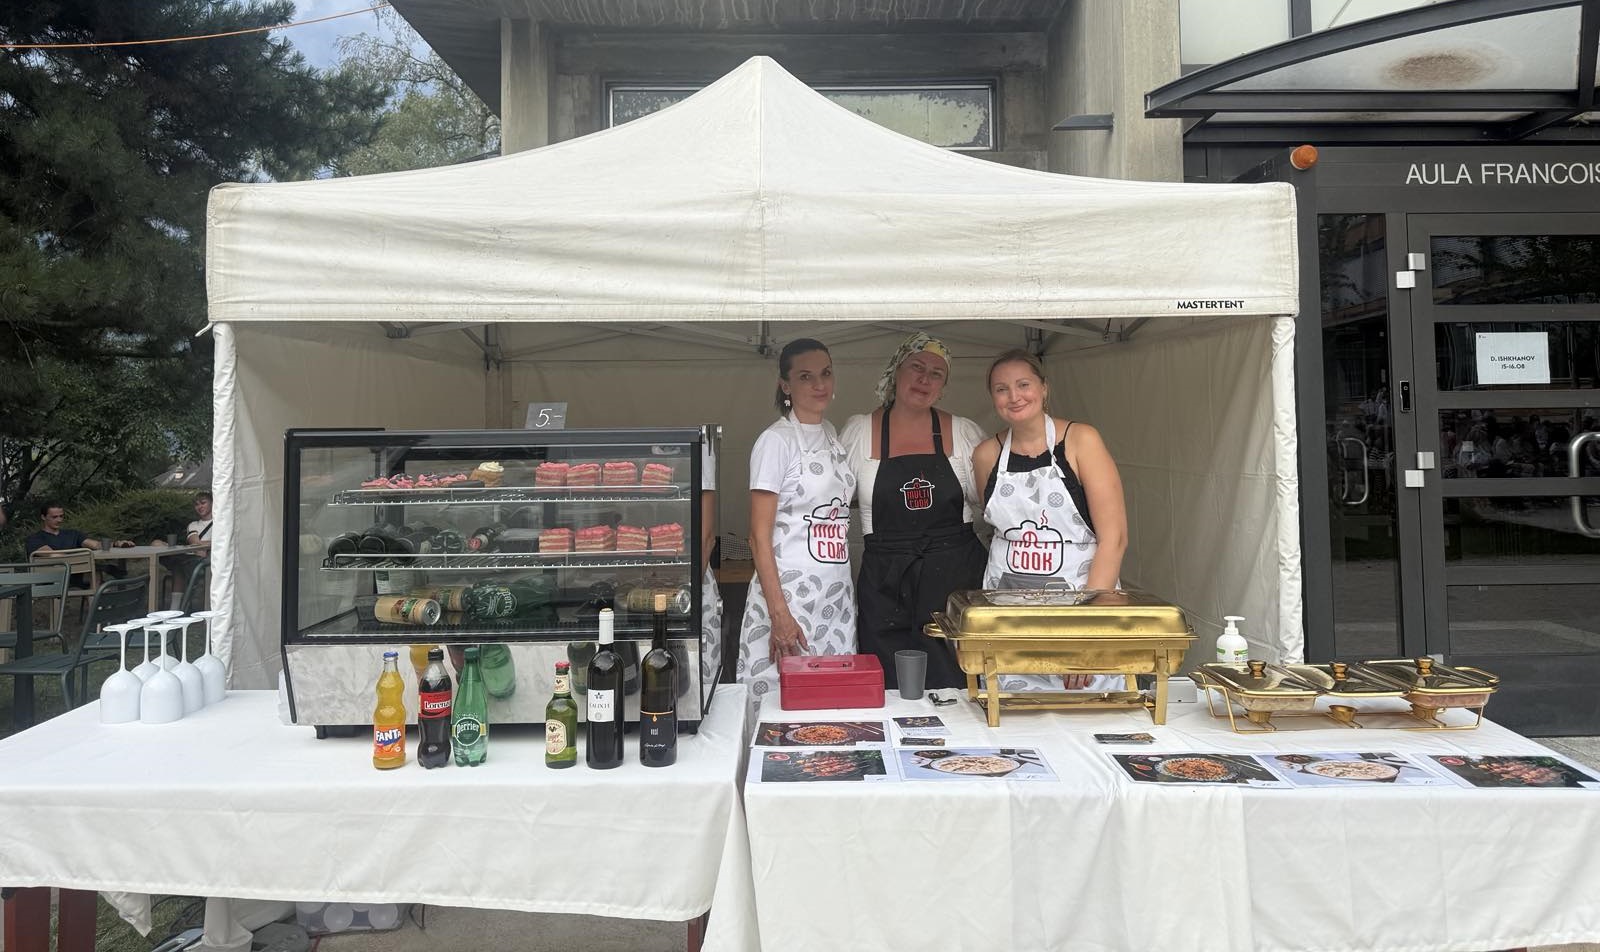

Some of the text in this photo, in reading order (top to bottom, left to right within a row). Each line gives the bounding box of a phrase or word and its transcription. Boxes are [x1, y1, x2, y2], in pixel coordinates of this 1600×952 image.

[1405, 163, 1473, 185] AULA
[1177, 300, 1245, 309] MASTERTENT
[1012, 550, 1053, 572] COOK
[375, 728, 402, 742] FANTA
